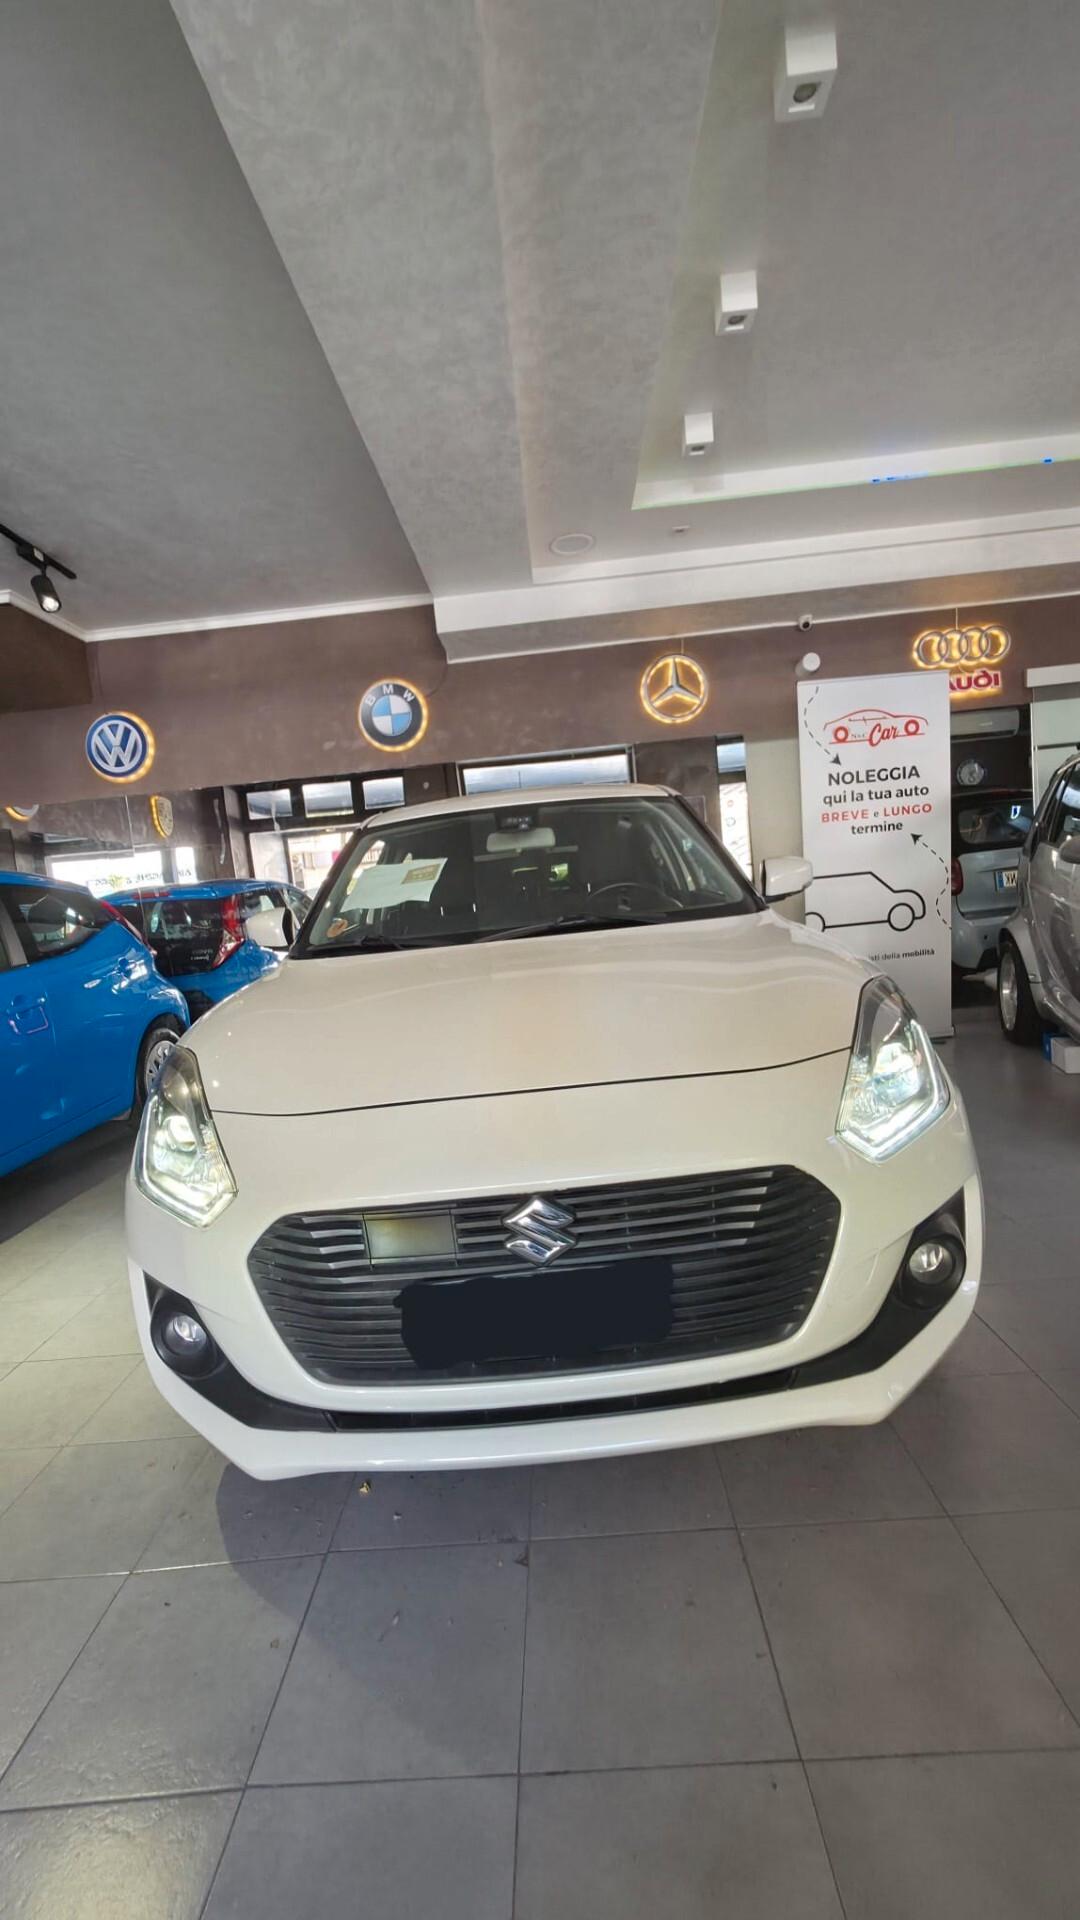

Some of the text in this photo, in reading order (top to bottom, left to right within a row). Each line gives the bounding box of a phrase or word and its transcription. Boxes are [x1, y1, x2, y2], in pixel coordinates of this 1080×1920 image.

[364, 684, 416, 707] BMW
[868, 723, 899, 747] Car
[827, 765, 920, 786] NOLEGGIA
[823, 784, 930, 806] qui la tua auto
[821, 809, 869, 824] BREVE
[883, 803, 933, 817] LUNGO
[851, 822, 903, 835] termine
[902, 948, 935, 958] mobilità
